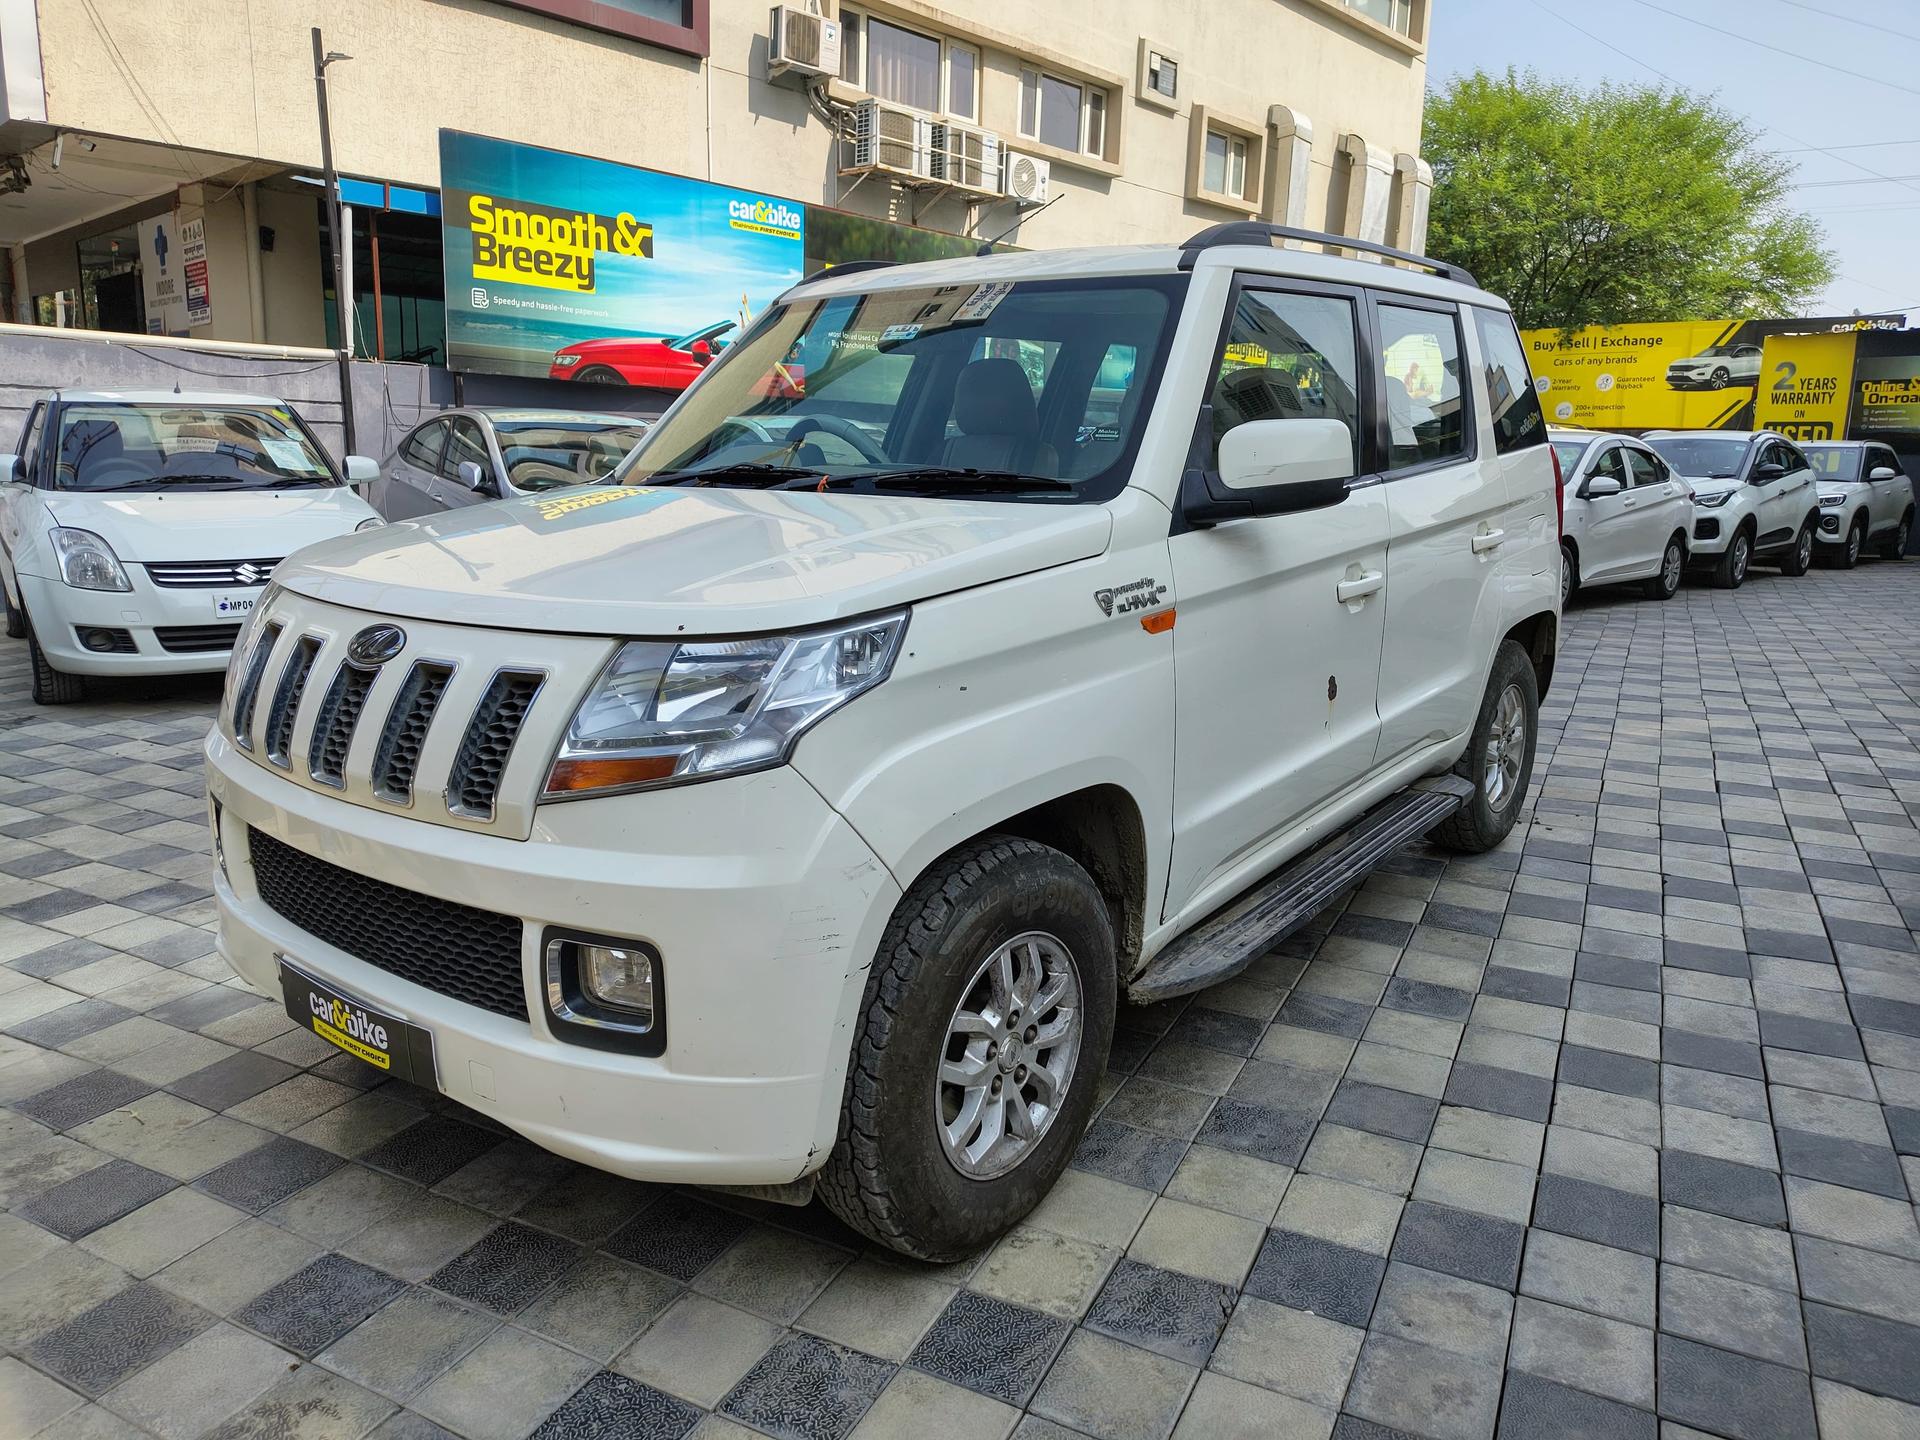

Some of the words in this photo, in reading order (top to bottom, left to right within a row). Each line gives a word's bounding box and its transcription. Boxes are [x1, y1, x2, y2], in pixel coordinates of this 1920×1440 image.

[729, 200, 801, 229] car&bike
[469, 195, 609, 252] Smooth
[612, 212, 653, 257] &
[760, 227, 775, 235] FIRST
[776, 230, 795, 238] CHOICE
[472, 232, 595, 291] Breezy
[493, 296, 520, 308] Speedy
[521, 300, 535, 309] and
[536, 302, 574, 314] hassle-free
[574, 308, 609, 317] paperwork
[1226, 343, 1265, 361] aughter
[1533, 340, 1556, 352] Buy
[1568, 337, 1590, 349] Sell
[1601, 336, 1663, 348] Exchange
[1553, 358, 1573, 367] Cars
[1575, 356, 1585, 365] of
[1587, 358, 1603, 367] any
[1605, 355, 1638, 364] brands
[1773, 361, 1797, 391] 2
[1800, 377, 1838, 391] YEARS
[1616, 383, 1643, 391] Buyback
[1862, 380, 1905, 393] Online
[1771, 392, 1835, 405] WARRANTY
[1869, 393, 1920, 404] On-roa
[1794, 409, 1805, 418] ON
[1768, 425, 1828, 441] SED
[230, 600, 254, 611] MP09
[309, 991, 389, 1050] car&bike
[343, 1039, 361, 1053] FIRST
[361, 1049, 387, 1064] CHOICE
